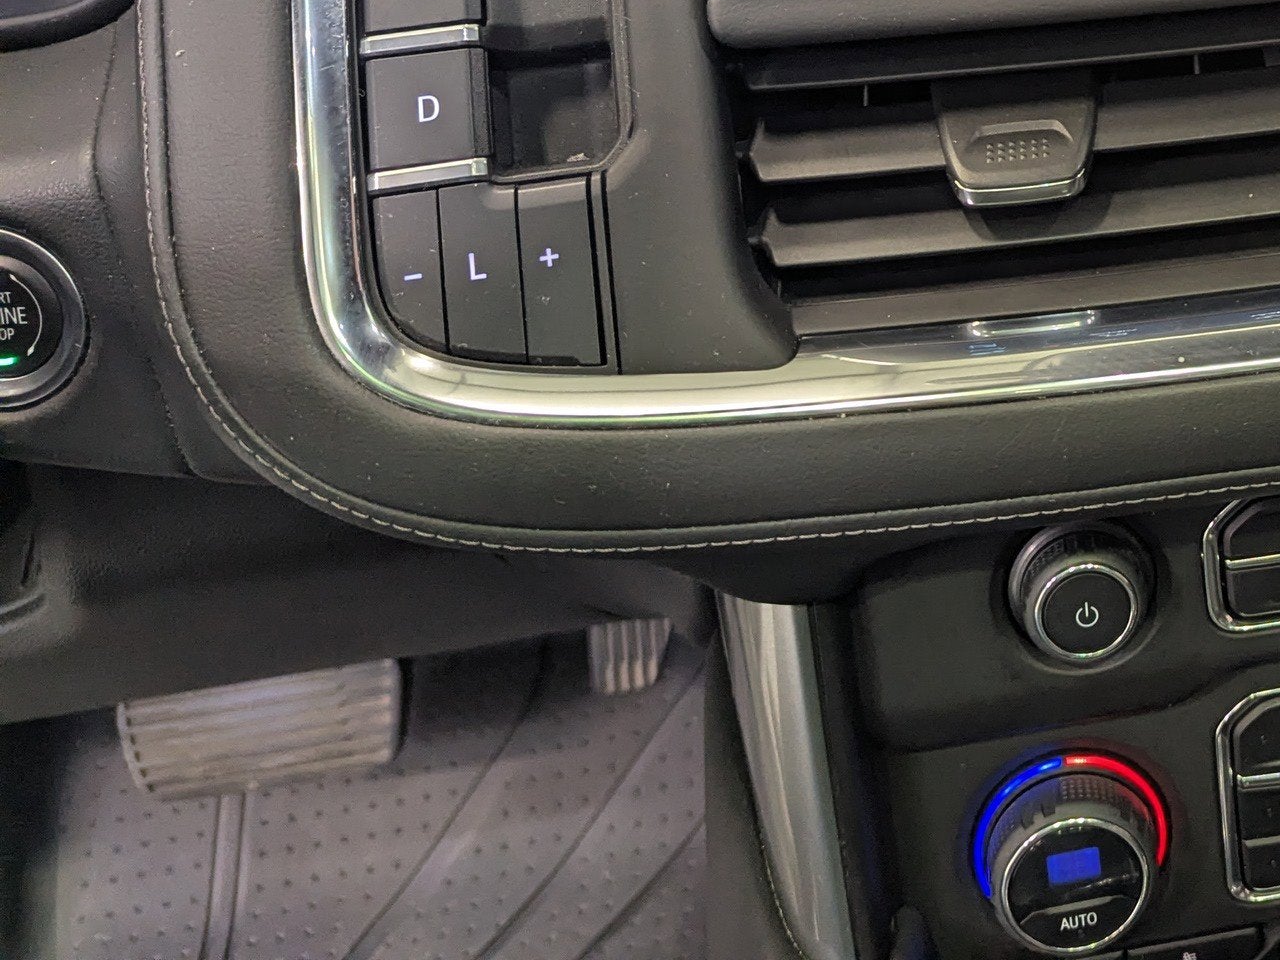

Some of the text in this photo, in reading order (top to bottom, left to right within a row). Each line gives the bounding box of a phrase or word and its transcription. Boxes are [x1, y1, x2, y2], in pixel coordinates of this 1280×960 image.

[417, 94, 441, 123] D
[468, 252, 487, 281] L
[1060, 911, 1098, 932] AUTO
